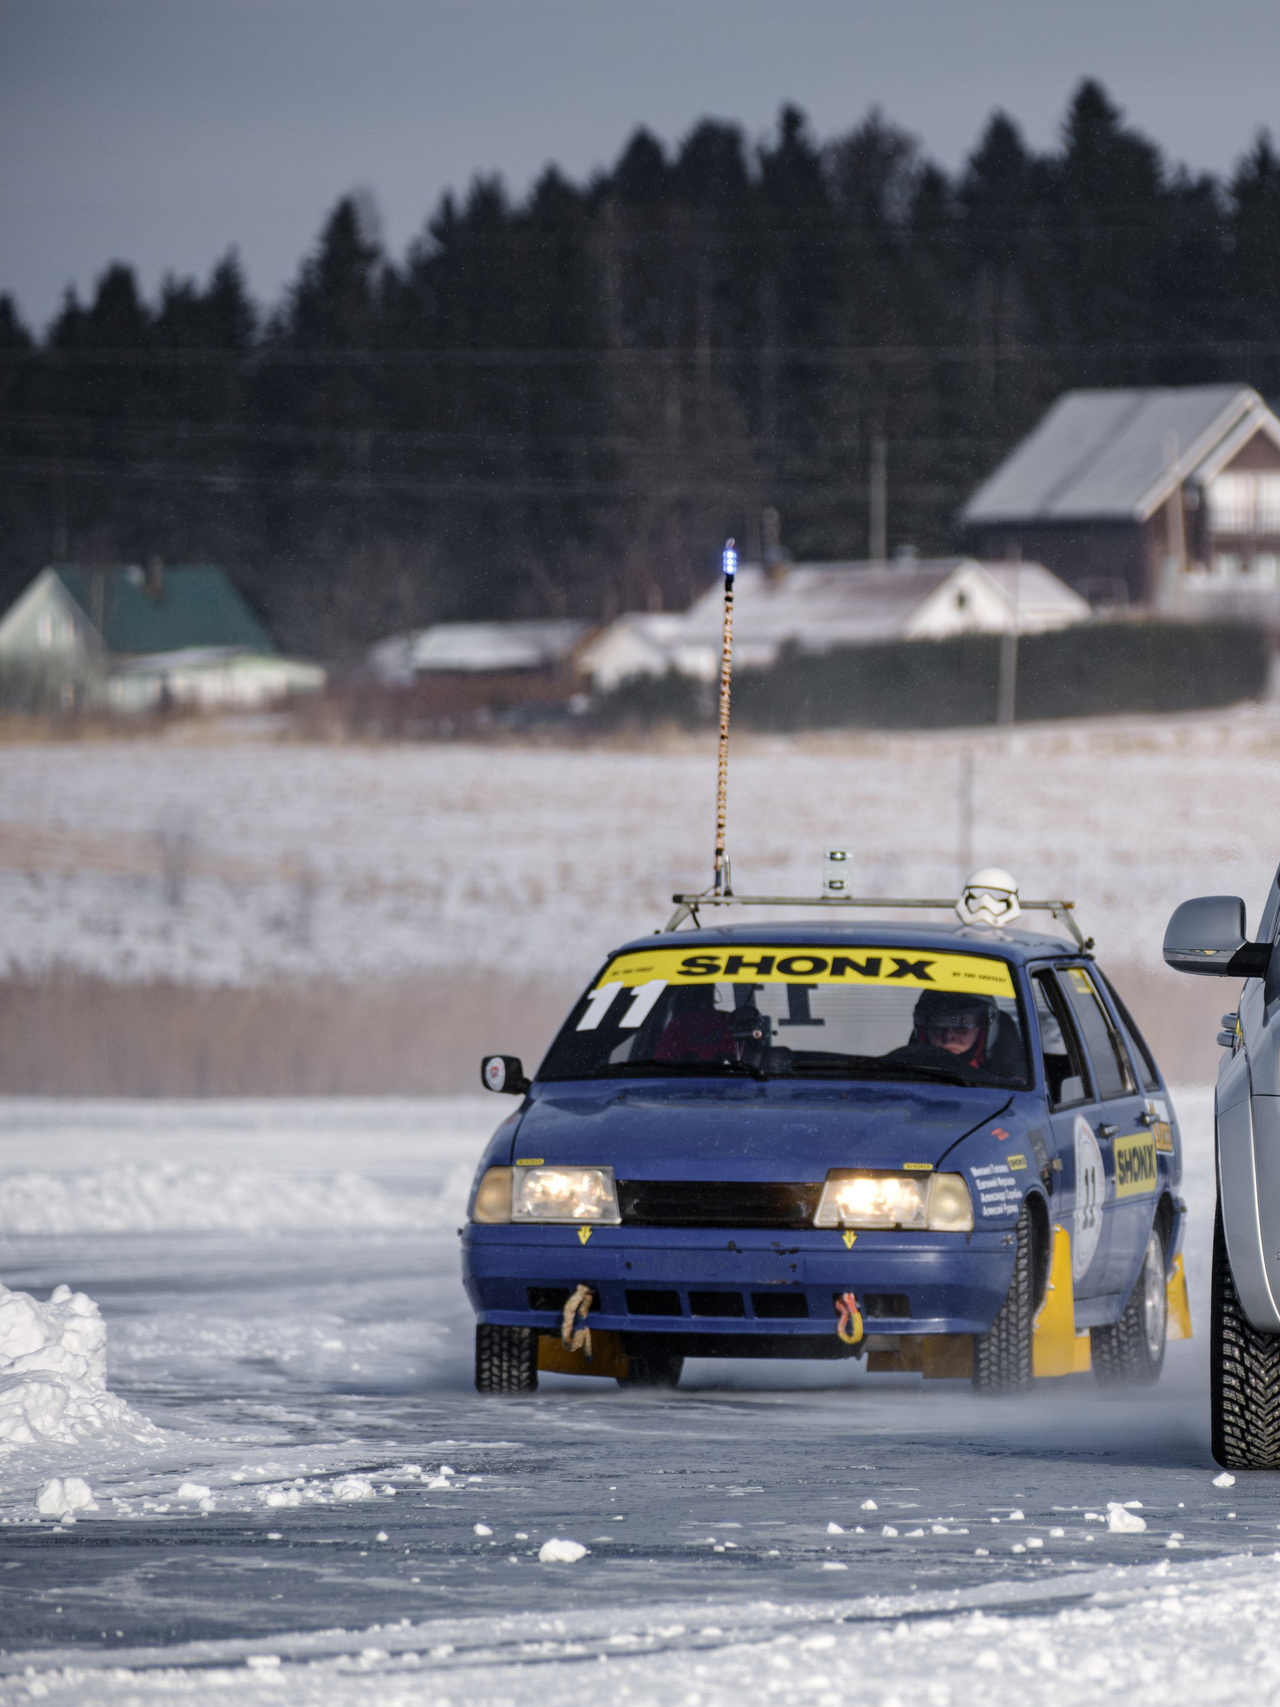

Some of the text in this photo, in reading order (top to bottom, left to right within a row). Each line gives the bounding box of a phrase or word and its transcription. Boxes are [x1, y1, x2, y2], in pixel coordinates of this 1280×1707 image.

[676, 955, 937, 982] SHONX
[576, 979, 669, 1031] 11
[1117, 1144, 1157, 1186] SHONX
